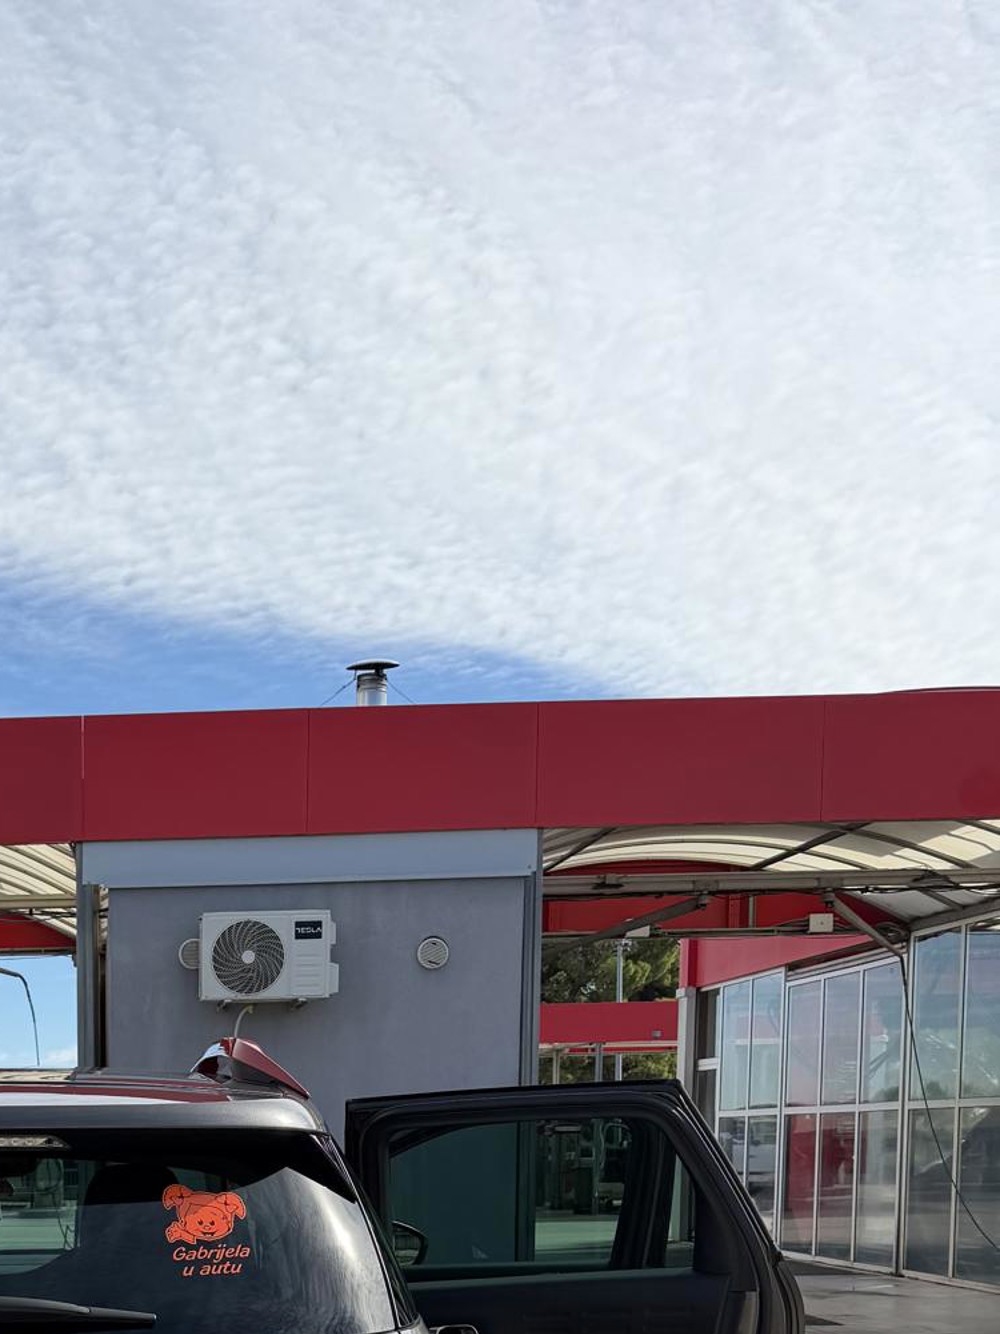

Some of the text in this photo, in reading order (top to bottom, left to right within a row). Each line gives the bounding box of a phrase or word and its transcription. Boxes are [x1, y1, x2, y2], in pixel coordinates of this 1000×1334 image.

[172, 1244, 251, 1263] Gabrijela
[183, 1261, 242, 1276] u autu
